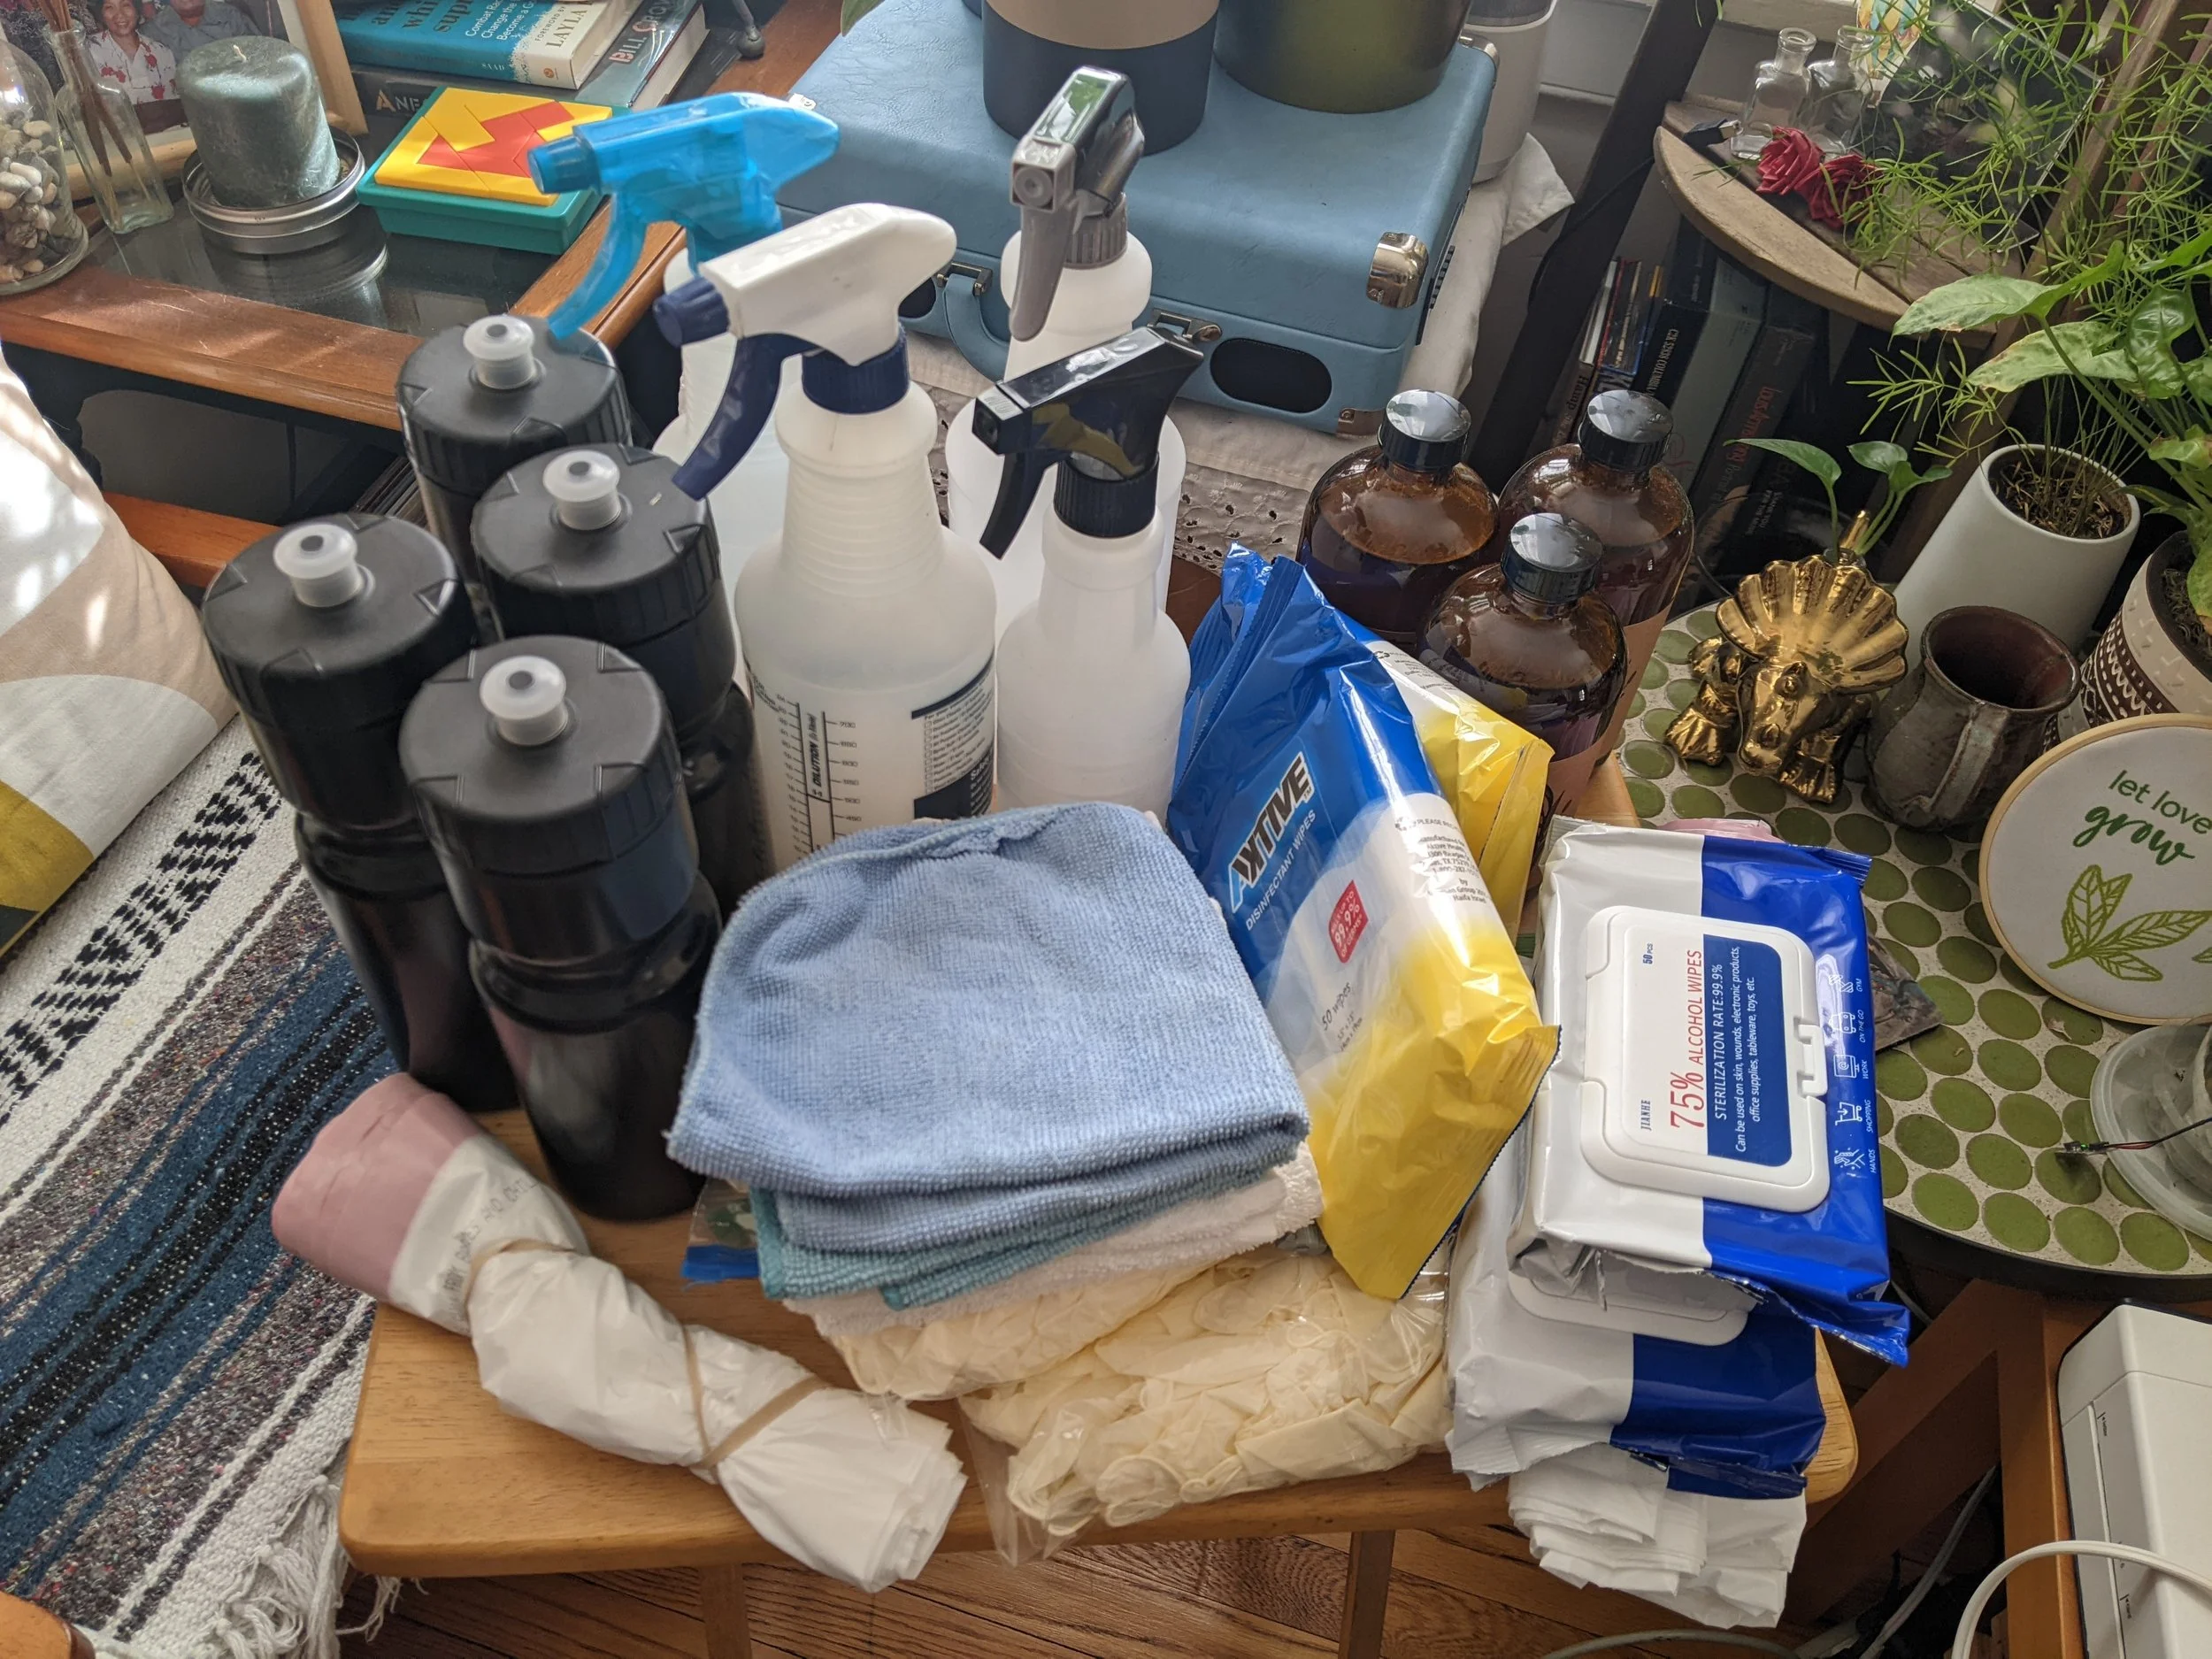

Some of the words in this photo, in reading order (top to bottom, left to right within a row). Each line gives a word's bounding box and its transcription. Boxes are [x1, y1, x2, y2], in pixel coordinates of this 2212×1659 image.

[465, 11, 495, 36] Combat
[481, 13, 509, 38] Change
[496, 14, 525, 41] Become
[534, 13, 560, 42] FOREWORD
[545, 10, 588, 48] LAYLA
[608, 36, 648, 63] BILL
[1567, 375, 1590, 411] Hamp
[2108, 769, 2151, 804] let
[2150, 790, 2212, 834] love
[2072, 805, 2196, 866] grow
[1246, 849, 1294, 932] DISINFECTANT
[1293, 809, 1317, 850] WIPES
[1334, 896, 1361, 949] 99.9%
[1643, 954, 1653, 964] 50
[1686, 949, 1702, 993] WIPES
[1731, 946, 1743, 984] products,
[1322, 1009, 1333, 1031] 50
[1332, 981, 1350, 1014] wipes
[1712, 964, 1726, 1027] RATE:99.9%
[1731, 984, 1741, 1025] electronic
[1747, 993, 1759, 1013] toys,
[1687, 996, 1703, 1065] ALCOHOL
[1858, 1009, 1864, 1019] GO
[1732, 1025, 1744, 1063] wounds,
[1747, 1014, 1758, 1057] tableware,
[1859, 1033, 1866, 1043] ON
[1713, 1031, 1727, 1120] STERILIZATION
[1732, 1064, 1744, 1082] skin,
[1735, 1083, 1744, 1096] on
[1748, 1057, 1762, 1097] supplies,
[1640, 1099, 1651, 1131] JIANHE
[1670, 1071, 1705, 1129] 75%
[1734, 1097, 1745, 1118] used
[1747, 1098, 1761, 1123] office
[1736, 1119, 1746, 1132] be
[1735, 1133, 1746, 1153] Can
[1869, 1148, 1878, 1174] HANDS
